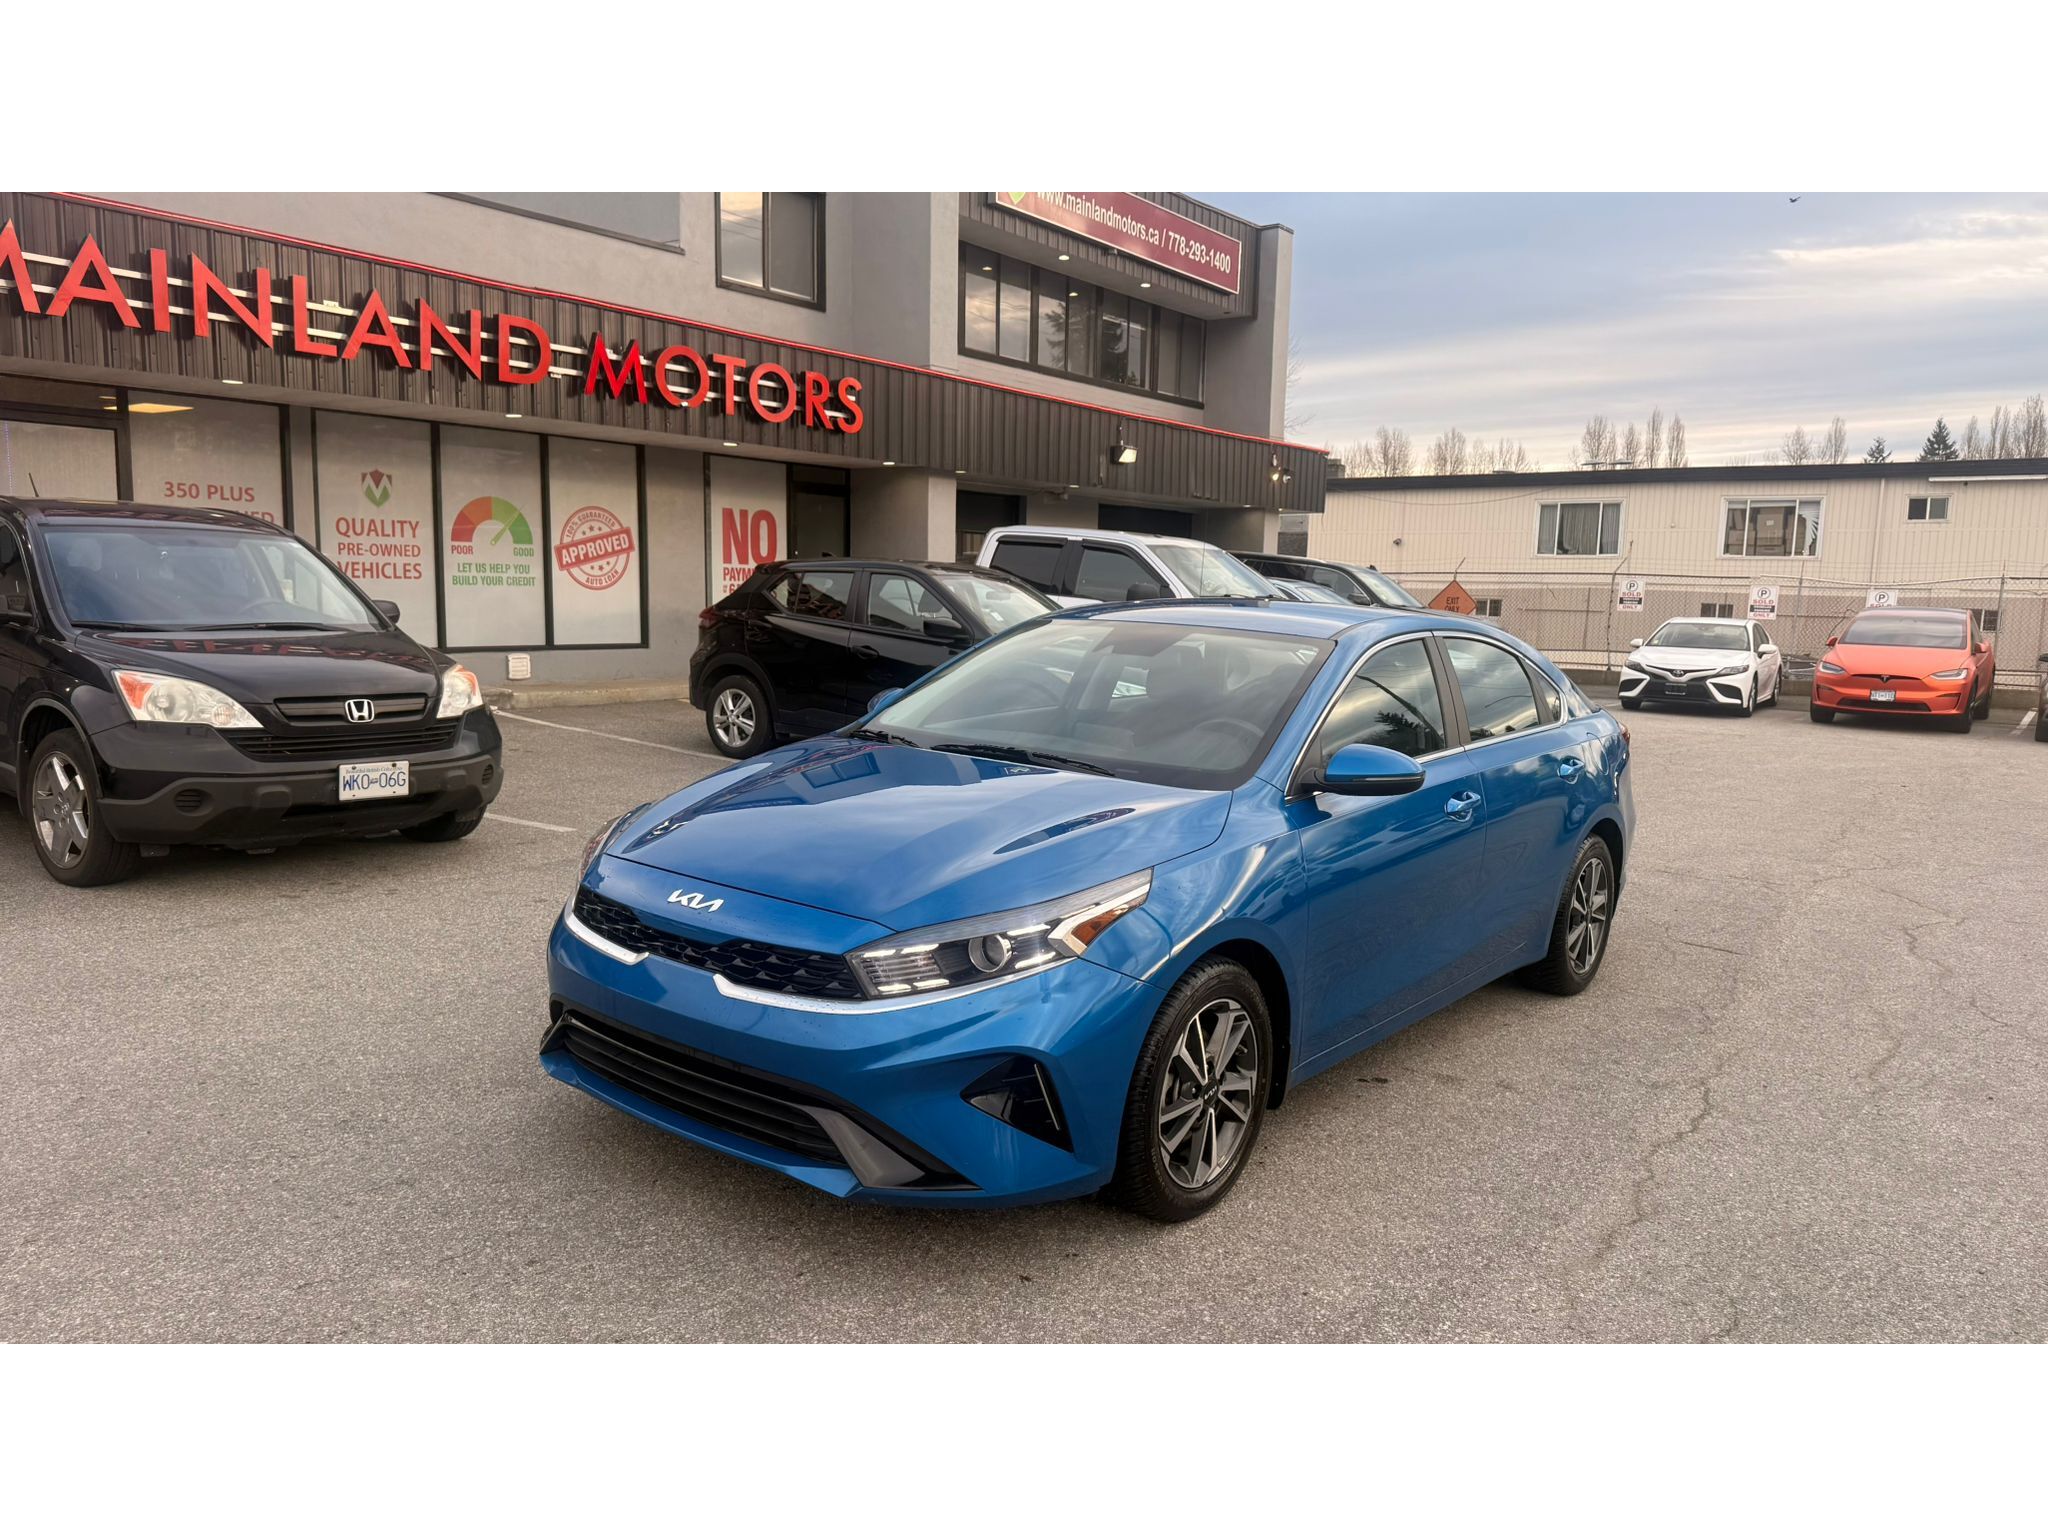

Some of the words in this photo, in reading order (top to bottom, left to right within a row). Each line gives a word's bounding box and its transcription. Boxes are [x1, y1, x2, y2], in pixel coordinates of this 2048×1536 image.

[1168, 231, 1231, 275] 778-293-1400
[583, 332, 865, 434] MOTORS
[164, 481, 200, 499] 350
[207, 484, 255, 502] PLUS
[335, 516, 420, 538] QUALITY
[722, 507, 777, 565] NO
[337, 542, 421, 557] PRE-OWNED
[451, 545, 473, 555] POOR
[513, 547, 534, 557] GOOD
[561, 533, 630, 565] APPROVED
[337, 560, 422, 580] VEHICLES
[457, 562, 472, 573] LET
[475, 563, 487, 573] US
[489, 563, 511, 574] HELP
[513, 564, 530, 574] YOU
[723, 567, 756, 581] PAYM
[452, 575, 478, 586] BUILD
[481, 576, 504, 586] YOUR
[506, 576, 536, 587] CREDIT
[1446, 596, 1460, 605] EXIT
[667, 888, 724, 913] KIA
